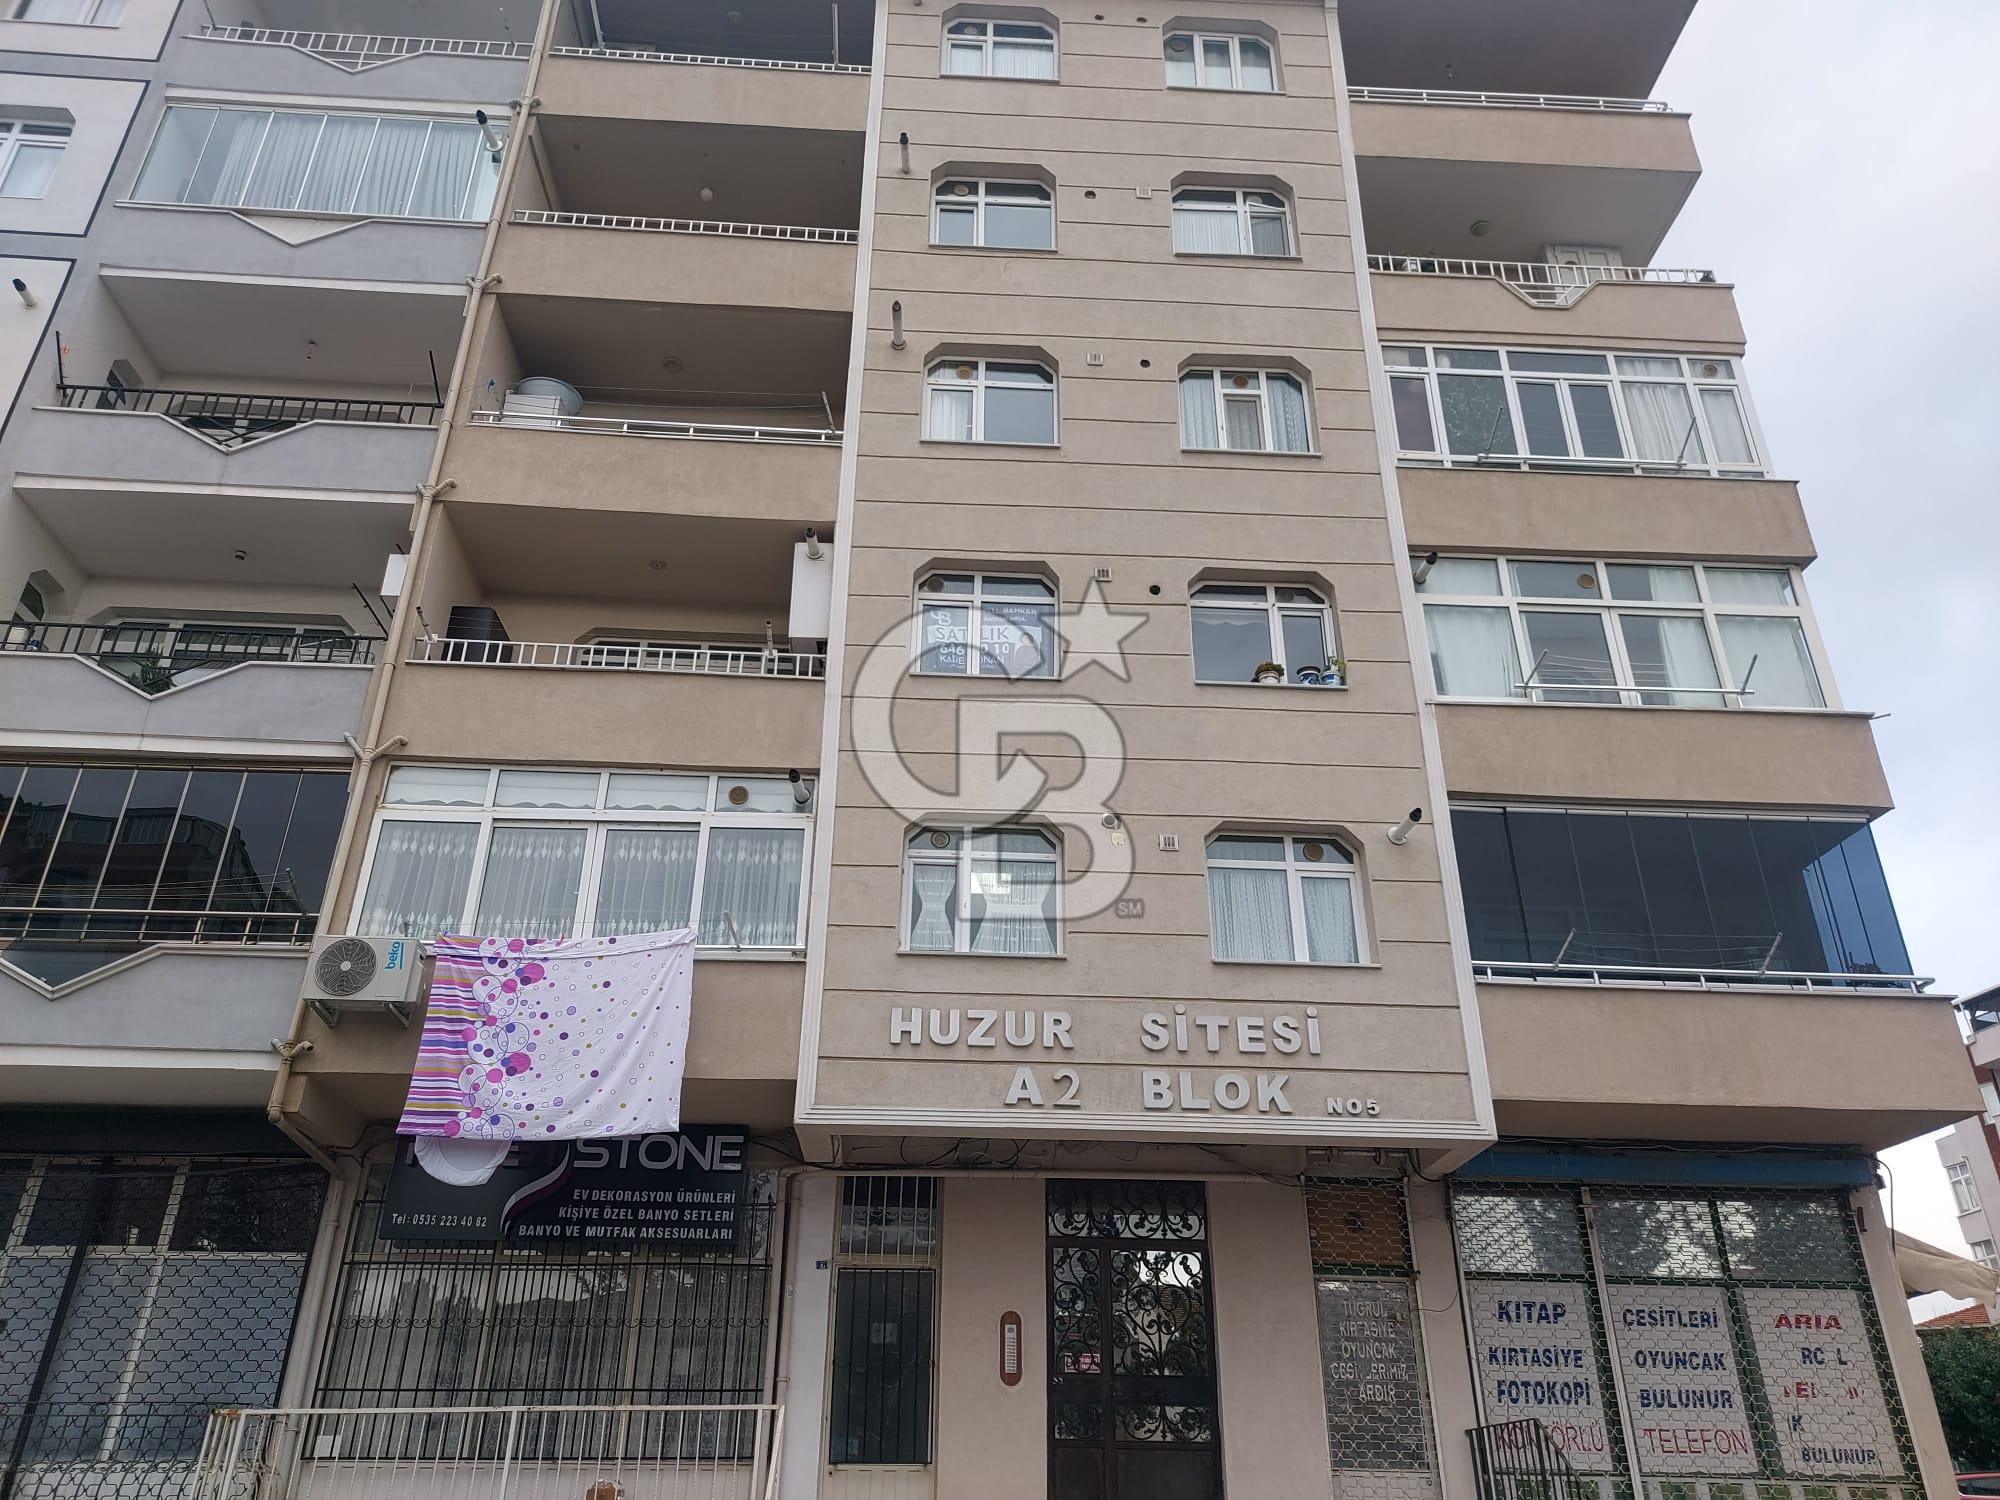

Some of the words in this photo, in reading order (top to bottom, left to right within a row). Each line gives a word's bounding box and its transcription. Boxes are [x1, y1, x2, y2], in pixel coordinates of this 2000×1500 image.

[384, 941, 401, 970] beko
[889, 1006, 1075, 1049] HUZUR
[1140, 1003, 1321, 1055] SİTESİ
[1004, 1066, 1082, 1108] A2
[1141, 1070, 1294, 1114] BLOK
[573, 1134, 745, 1171] STONE
[573, 1188, 590, 1201] EV
[592, 1189, 673, 1203] DEKORASYON
[676, 1188, 736, 1204] ÜRÜNLERİ
[392, 1213, 411, 1225] Tel:
[412, 1214, 437, 1226] 0535
[440, 1215, 458, 1226] 223
[460, 1216, 473, 1227] 40
[475, 1216, 488, 1228] 82
[558, 1204, 600, 1221] KİŞİYE
[603, 1204, 635, 1220] ÖZEL
[637, 1208, 679, 1221] BANYO
[683, 1207, 735, 1222] SETLERİ
[518, 1224, 561, 1237] BANYO
[565, 1225, 581, 1237] VE
[585, 1226, 636, 1238] MUTFAK
[639, 1227, 734, 1240] AKSESUARLARI
[1774, 1313, 1843, 1330] ARIA
[1634, 1350, 1727, 1371] OYUNCAK
[1496, 1377, 1591, 1406] FOTOKOPİ
[1639, 1388, 1733, 1409] BULUNUR
[1643, 1428, 1749, 1455] TELEFON
[1801, 1447, 1877, 1465] BULUNUR
